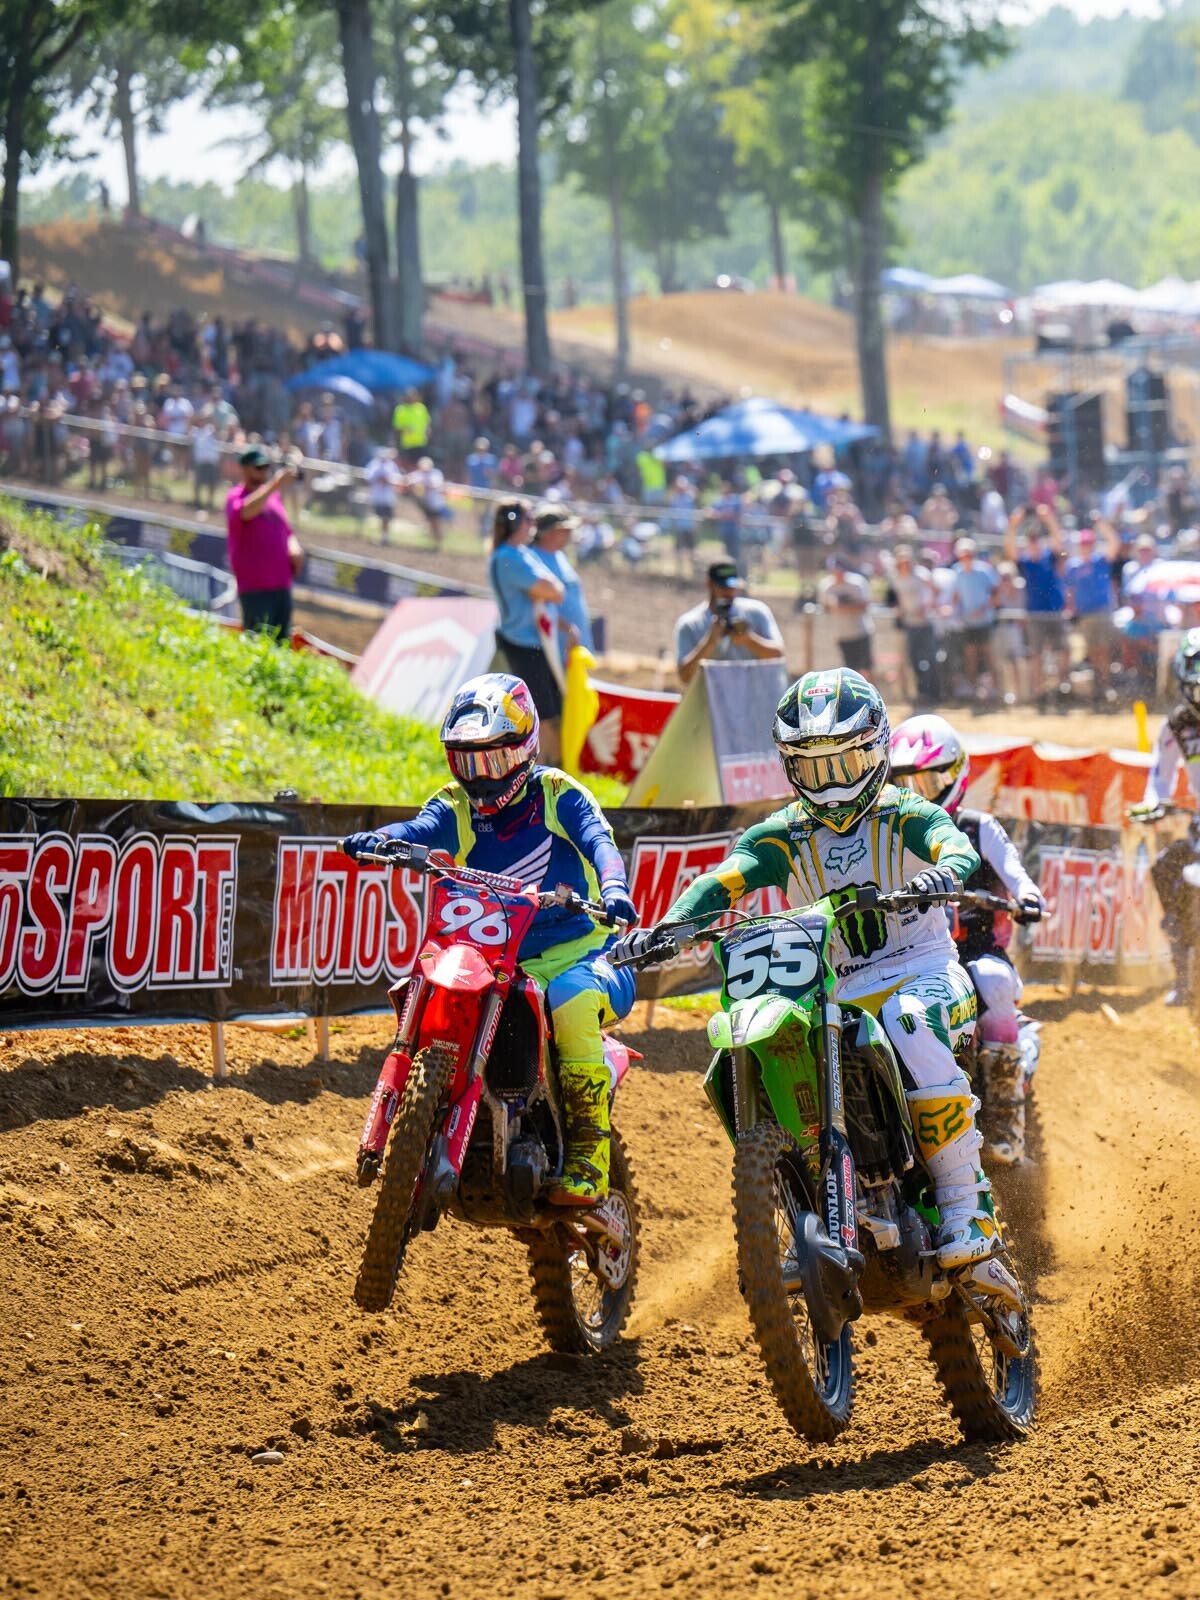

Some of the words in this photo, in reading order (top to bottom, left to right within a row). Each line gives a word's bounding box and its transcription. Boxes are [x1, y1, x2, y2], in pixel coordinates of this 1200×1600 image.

[807, 688, 831, 696] BELL
[459, 871, 518, 891] RENTHAL
[438, 897, 512, 946] 96
[726, 929, 824, 1000] 55
[361, 1080, 386, 1144] DUNLOP
[459, 1100, 478, 1167] DUNLOP
[843, 1154, 853, 1200] BRAKING
[827, 1167, 841, 1244] DUNLOP
[971, 1243, 985, 1260] FOX
